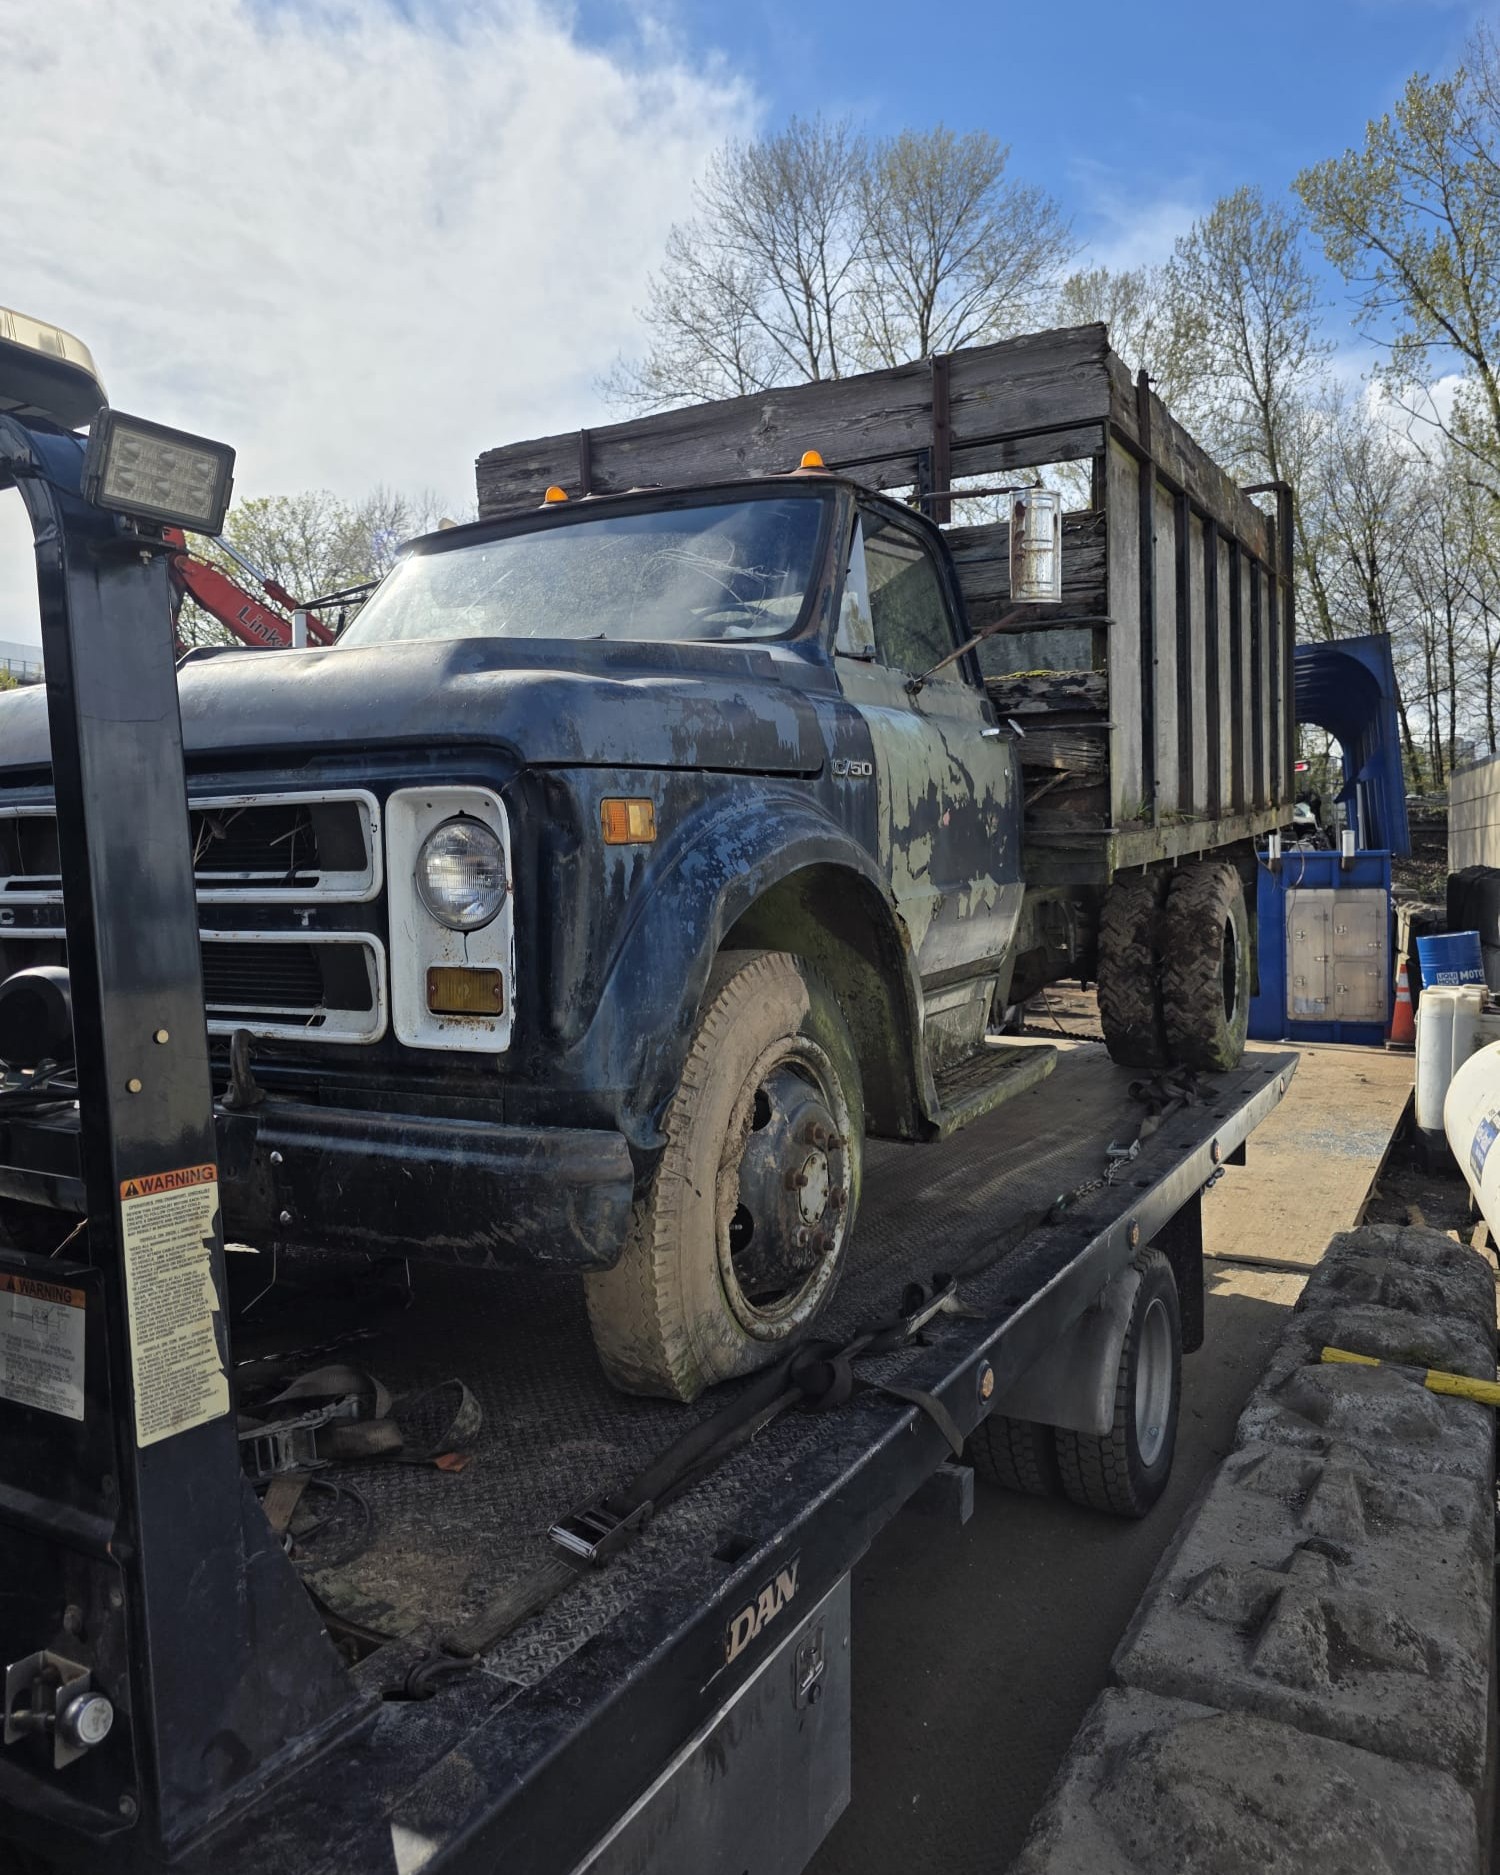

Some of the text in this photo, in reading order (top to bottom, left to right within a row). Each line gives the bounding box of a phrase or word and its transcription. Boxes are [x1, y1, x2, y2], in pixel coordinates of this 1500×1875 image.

[140, 1166, 214, 1193] WARNING
[20, 1279, 72, 1303] WARNING
[727, 1560, 800, 1664] DAN
